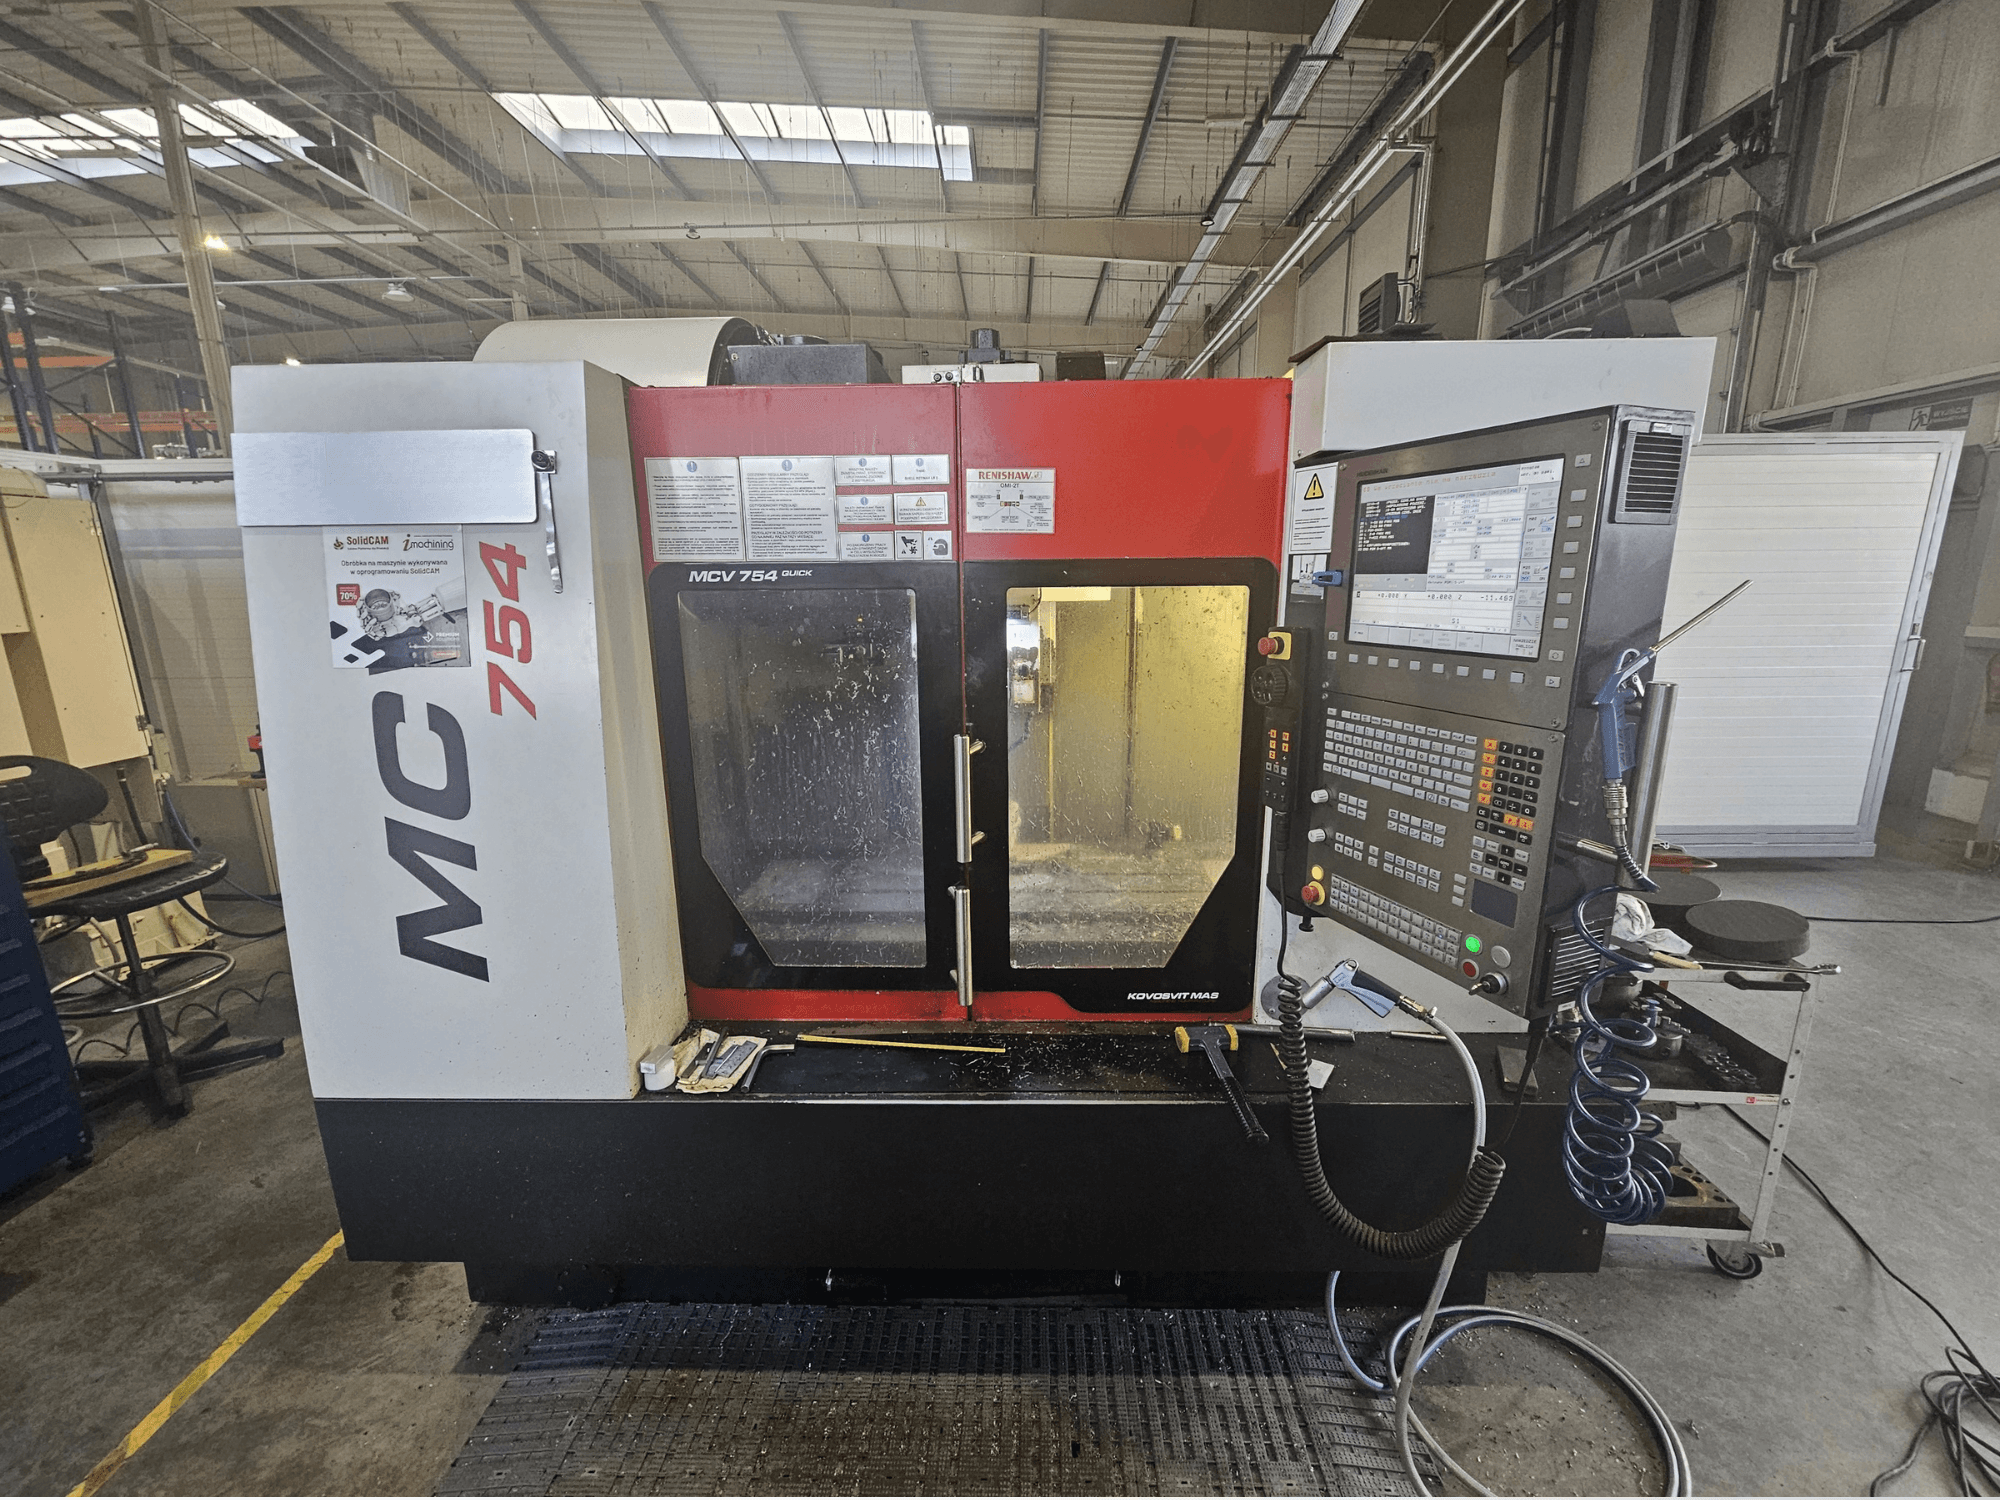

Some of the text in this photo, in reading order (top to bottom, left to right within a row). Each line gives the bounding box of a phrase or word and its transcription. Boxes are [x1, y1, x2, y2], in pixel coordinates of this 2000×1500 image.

[978, 471, 1031, 480] RENISHAW
[347, 536, 389, 545] SolidCAM
[688, 569, 813, 582] MCV 754 QUICK
[340, 592, 358, 600] 70%
[478, 541, 537, 721] 754
[1127, 992, 1219, 1000] KOVOSVIT MAS
